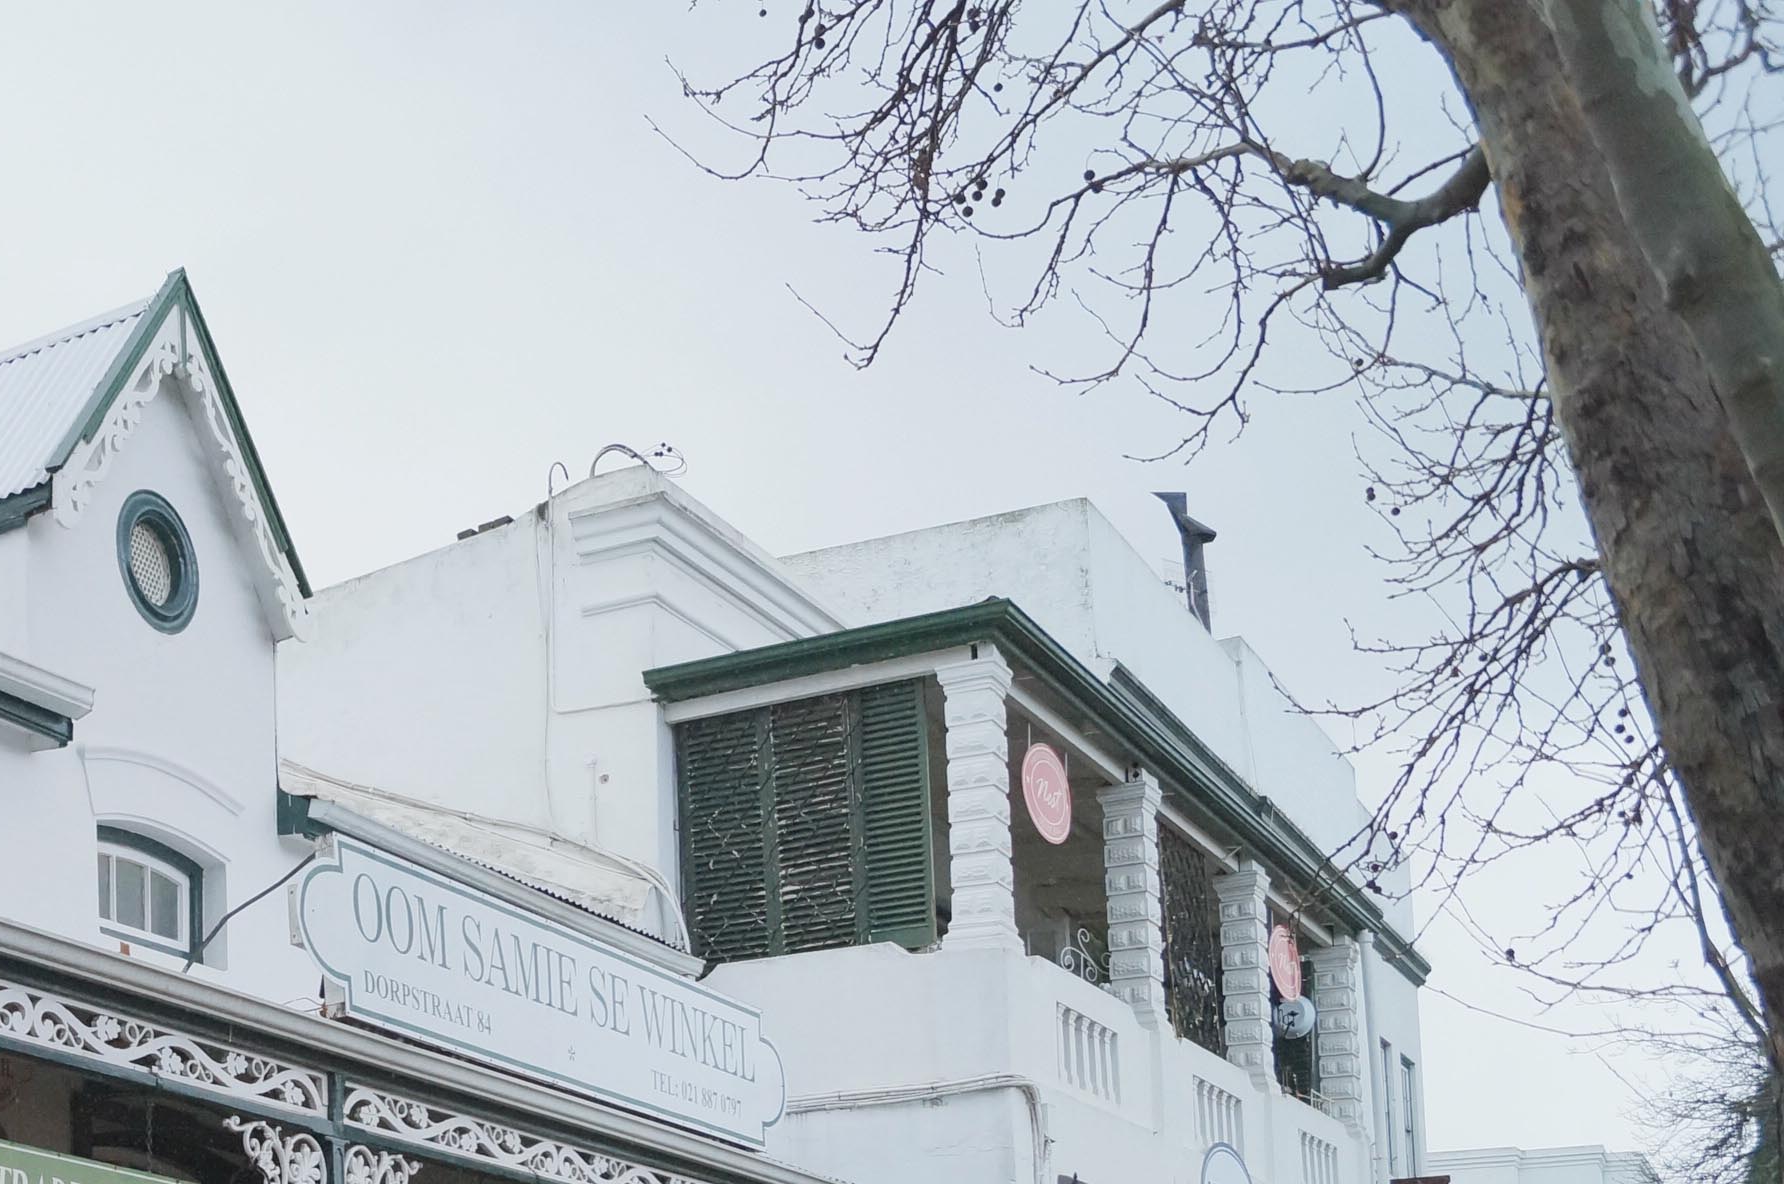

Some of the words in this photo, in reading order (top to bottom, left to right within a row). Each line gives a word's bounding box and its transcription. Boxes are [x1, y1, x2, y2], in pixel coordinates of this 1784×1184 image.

[353, 873, 451, 971] OOM
[462, 915, 578, 1017] SAMIE
[589, 965, 630, 1036] SE
[637, 984, 755, 1083] WINKEL
[364, 970, 473, 1028] DORPSTRAAT
[476, 1010, 492, 1034] 84
[651, 1069, 678, 1097] TEL:
[681, 1081, 698, 1104] 021
